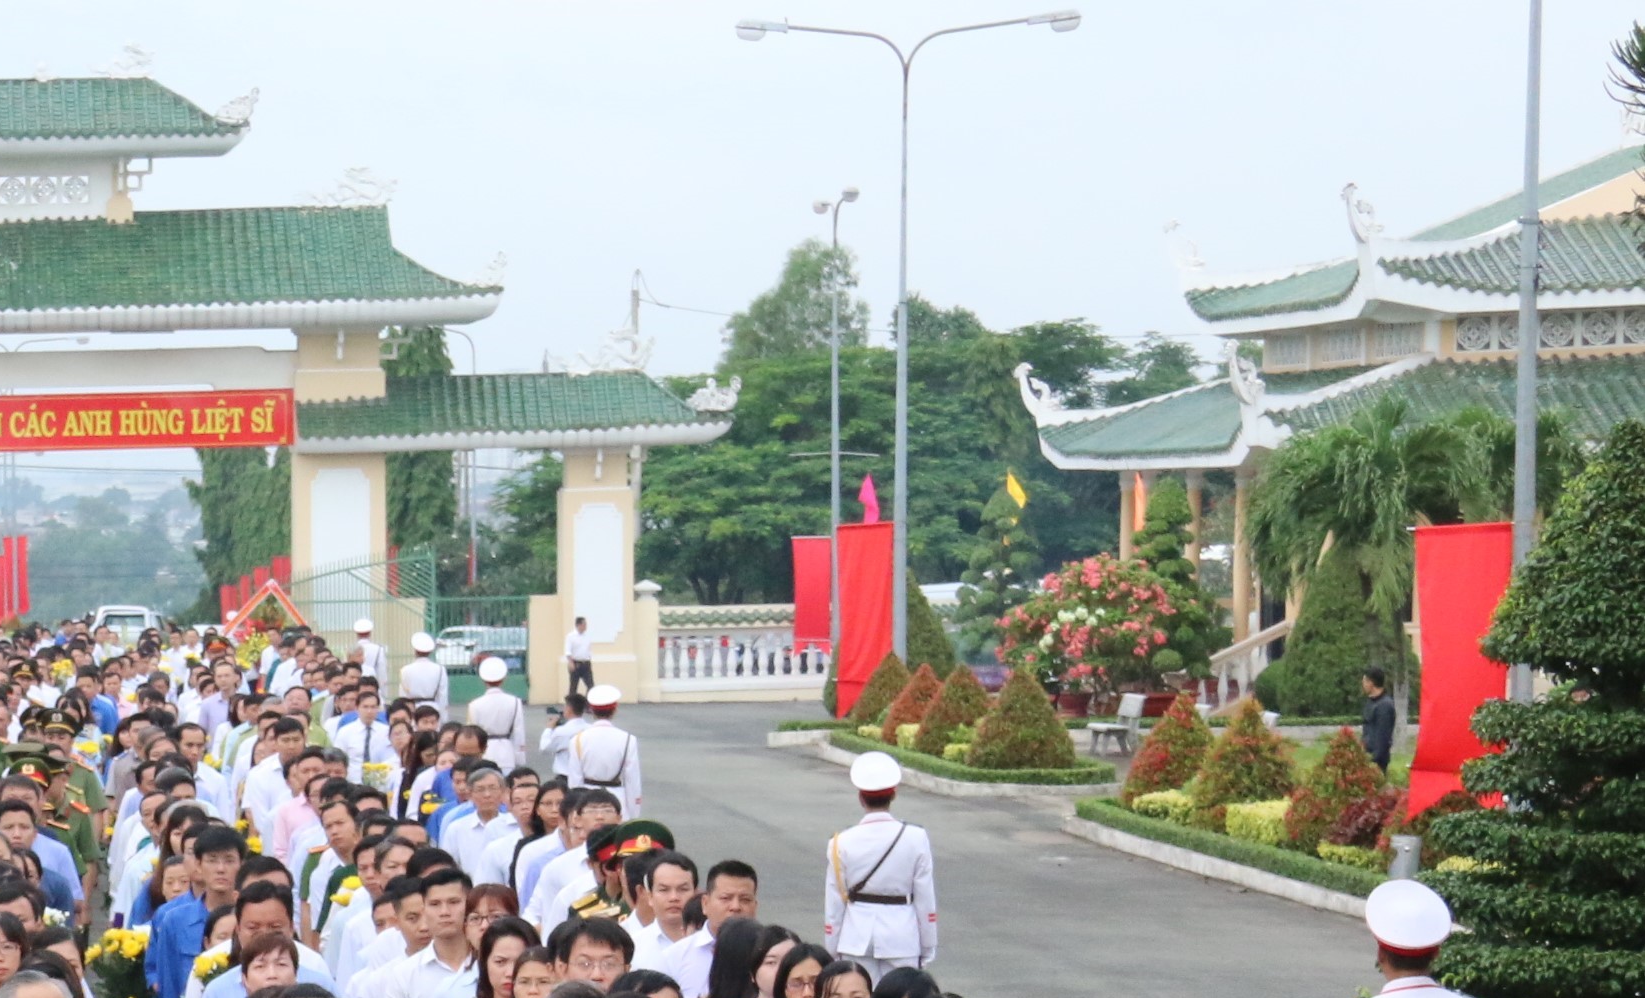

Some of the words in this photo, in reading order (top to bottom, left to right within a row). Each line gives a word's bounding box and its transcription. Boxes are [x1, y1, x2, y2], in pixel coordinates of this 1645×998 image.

[9, 403, 57, 438] CÁC
[62, 410, 113, 437] ANH
[119, 401, 185, 436] HÙNG
[190, 399, 245, 441] LIỆT
[250, 398, 277, 434] SĨ
